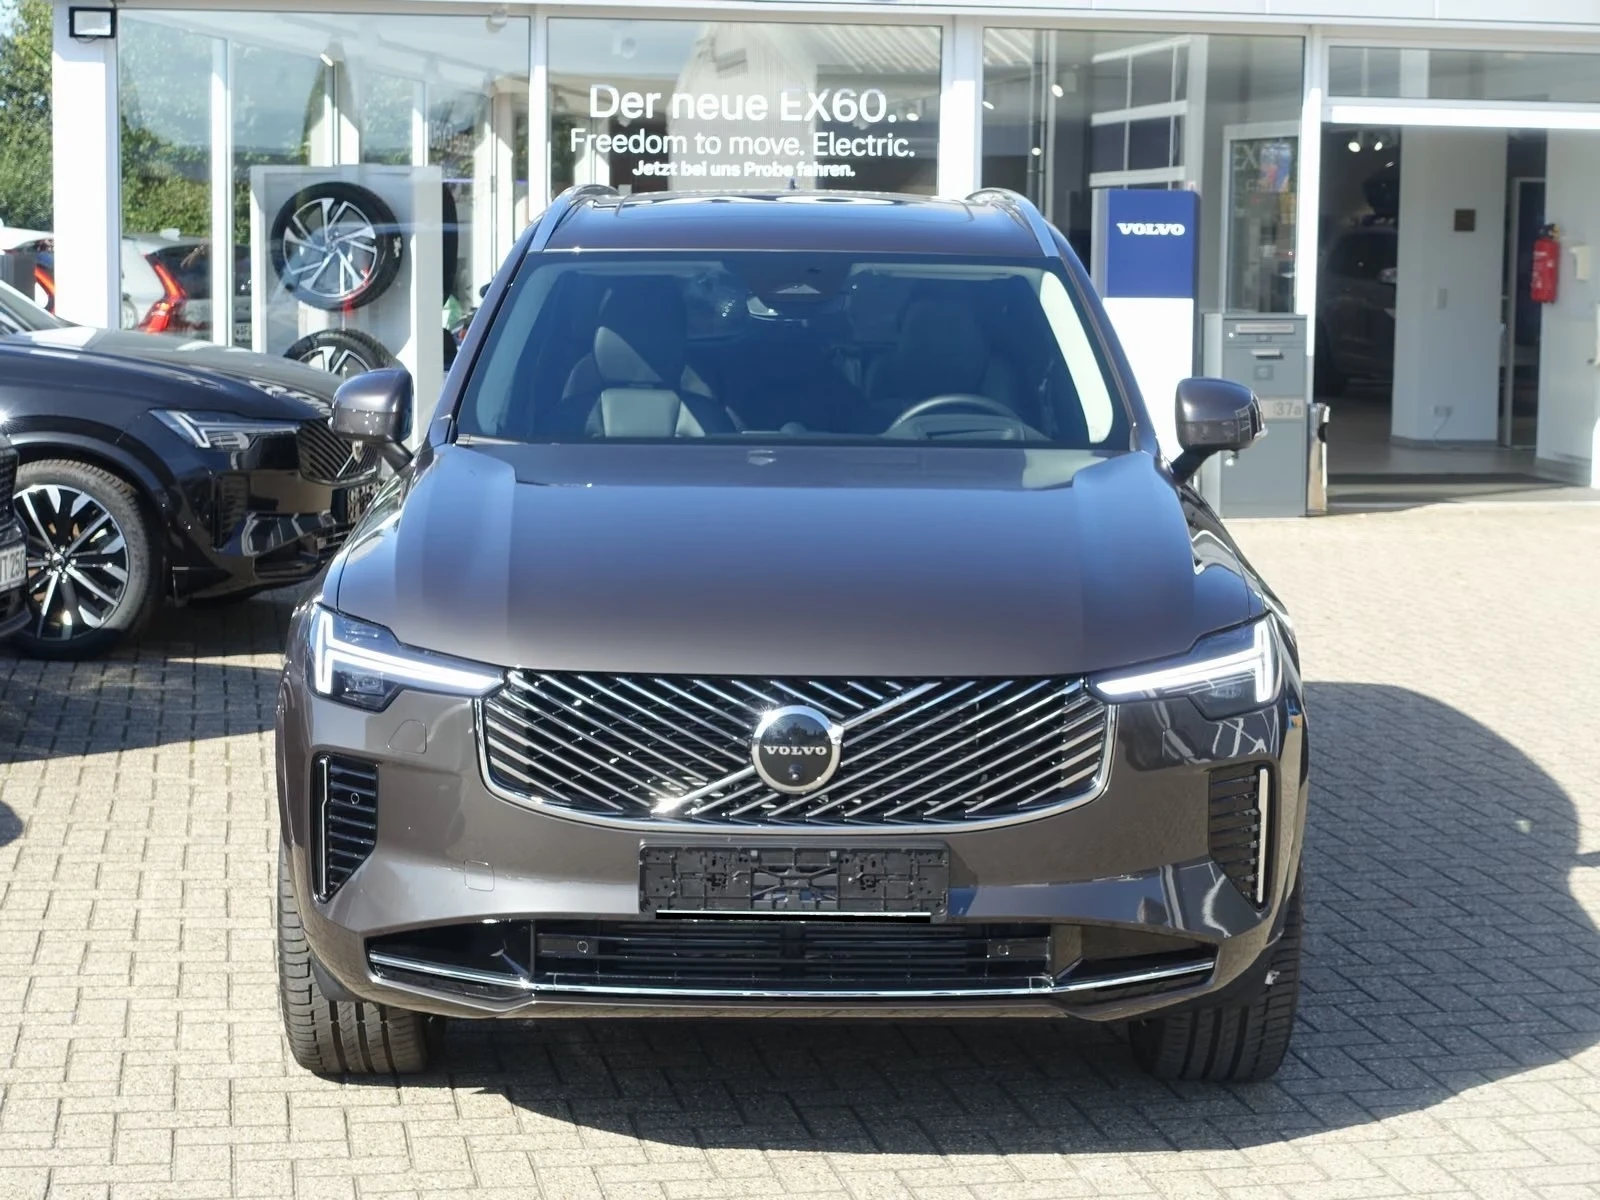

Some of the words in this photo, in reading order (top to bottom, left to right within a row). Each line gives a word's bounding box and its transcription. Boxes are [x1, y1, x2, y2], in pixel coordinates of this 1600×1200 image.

[590, 84, 661, 118] Der
[672, 92, 768, 121] neue
[780, 88, 897, 123] EX60.
[571, 128, 687, 154] Freedom
[695, 132, 722, 155] to
[729, 136, 805, 156] move.
[813, 131, 916, 157] Electric.
[632, 160, 678, 176] Jetzt
[681, 161, 707, 176] bei
[710, 164, 741, 176] uns
[744, 161, 794, 177] Probe
[796, 161, 856, 177] fahren.
[1116, 222, 1186, 236] VOLVO
[763, 745, 828, 756] VOLVO
